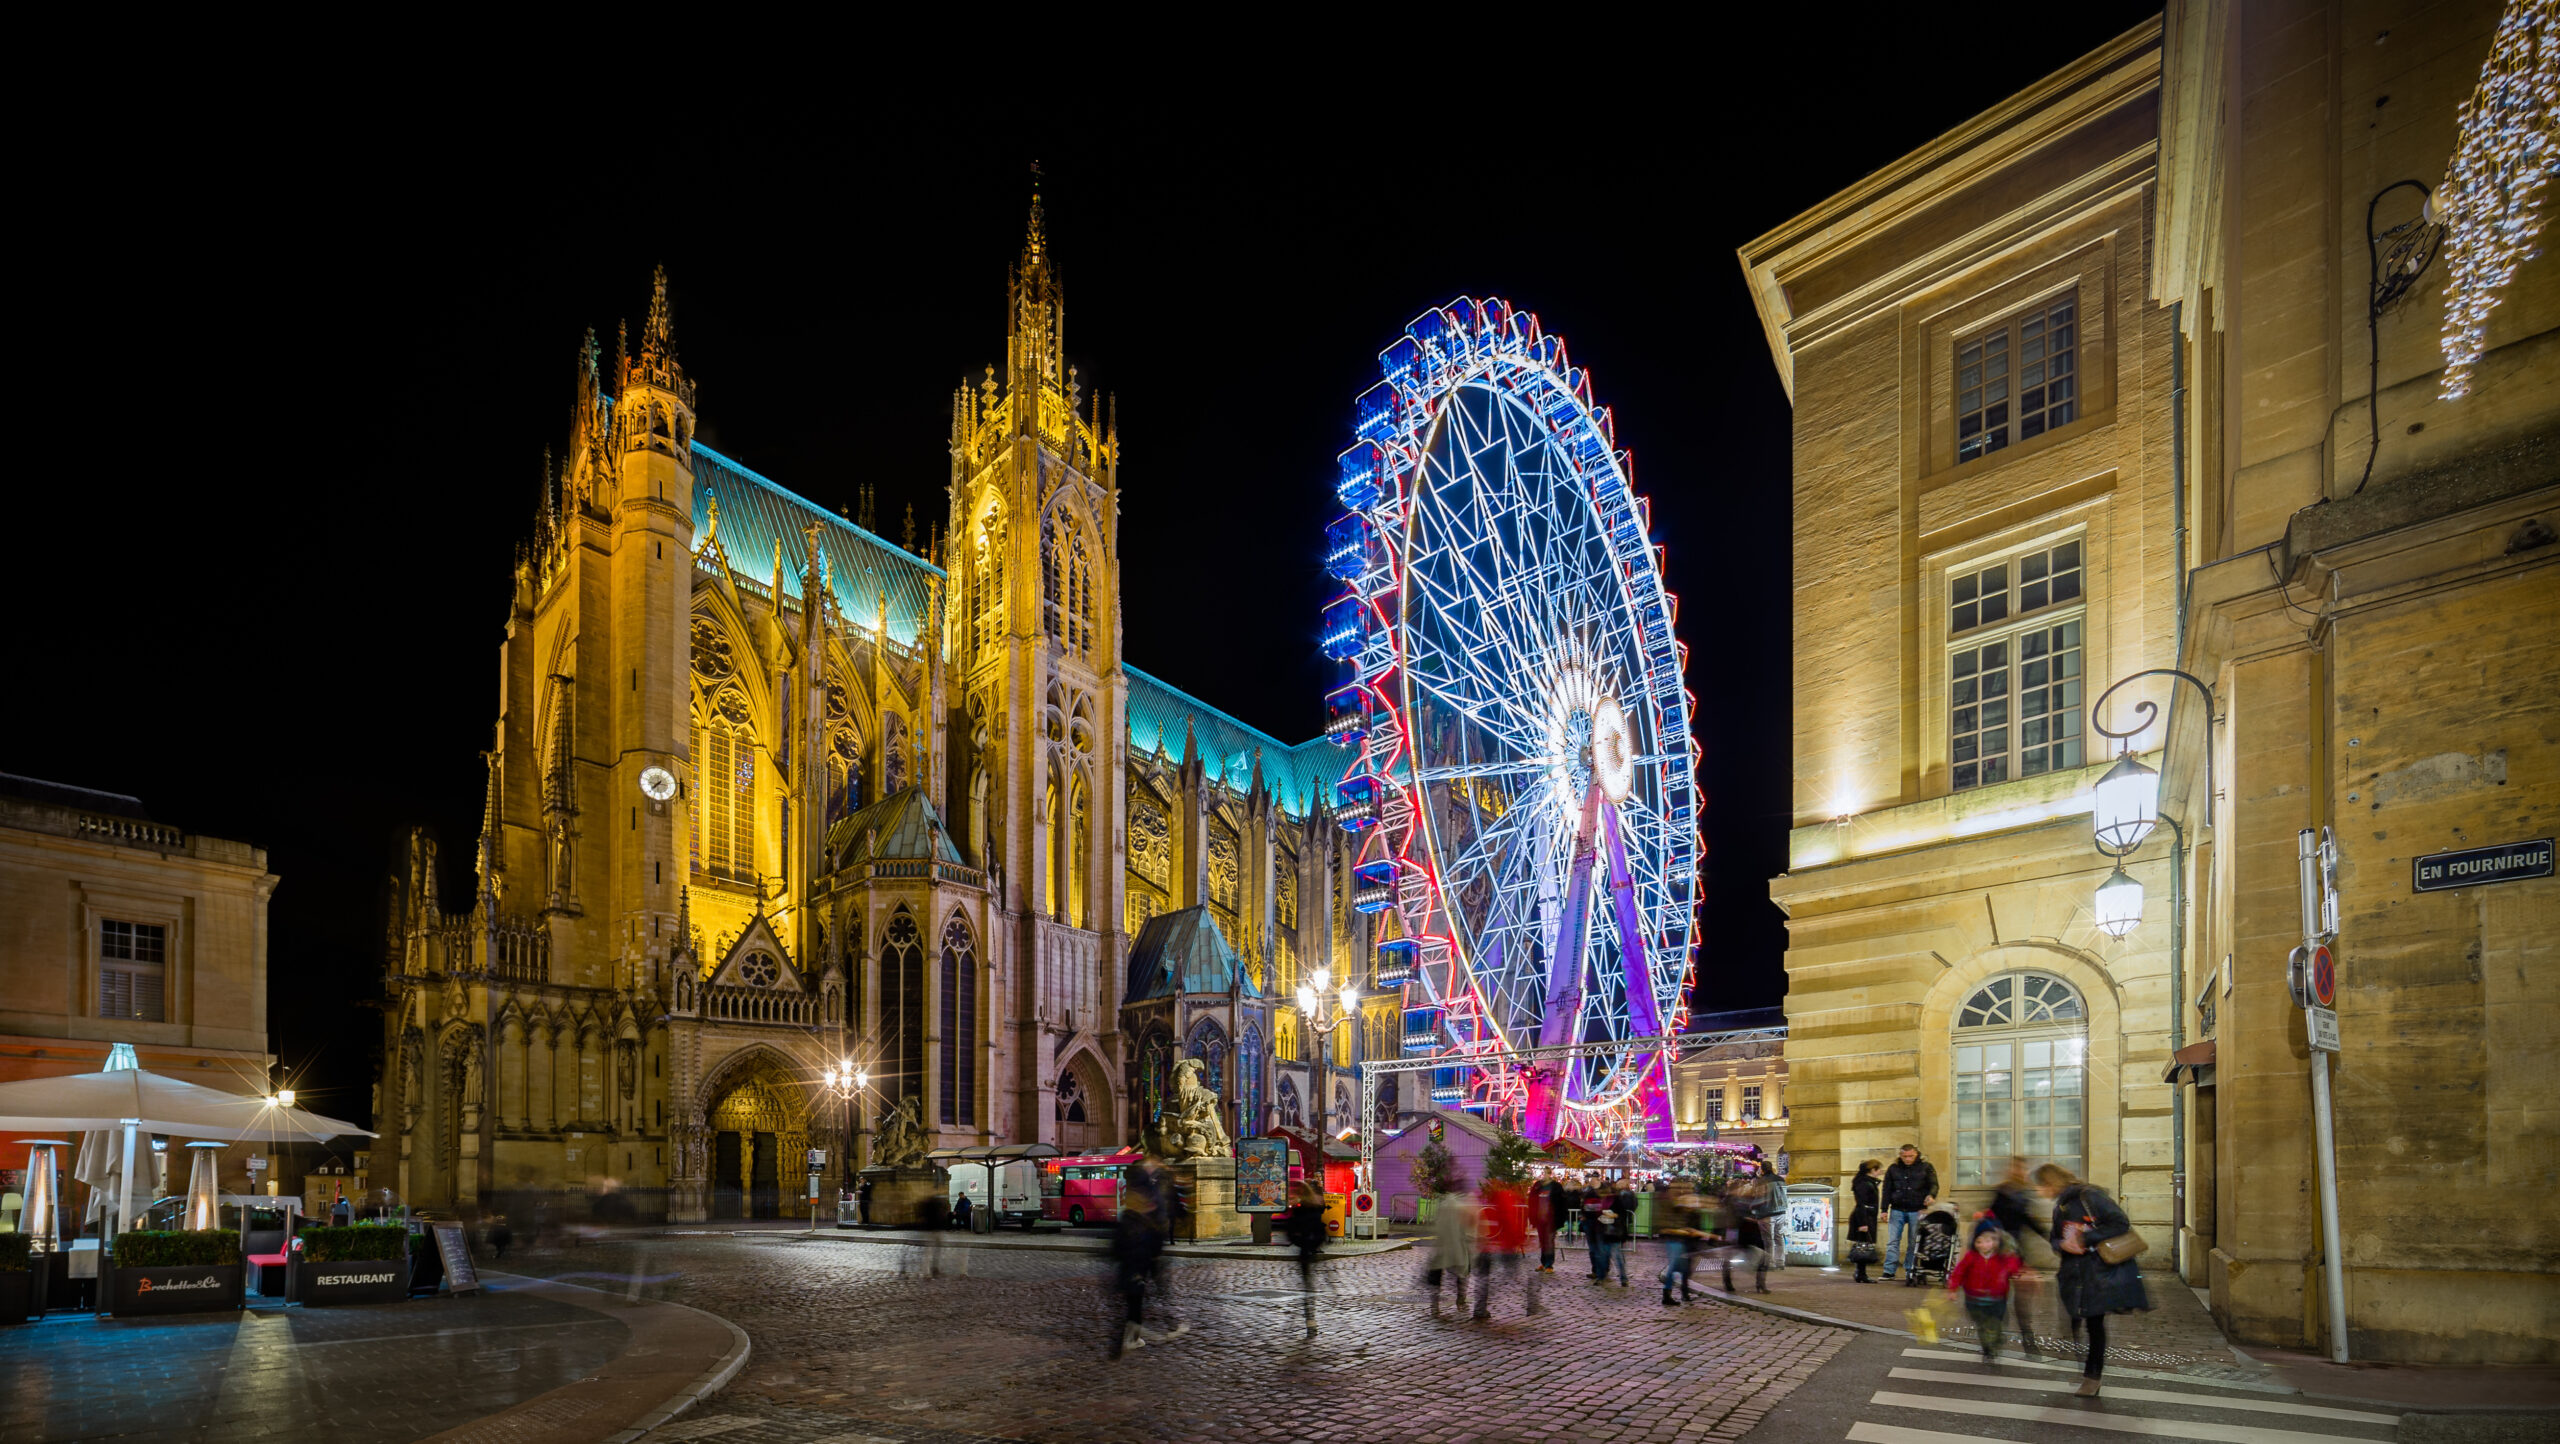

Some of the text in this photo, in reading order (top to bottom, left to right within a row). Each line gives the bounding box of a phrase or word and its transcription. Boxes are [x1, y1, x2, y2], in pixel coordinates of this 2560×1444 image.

[2420, 850, 2549, 880] EN FOURNIRUE
[316, 1273, 395, 1286] RESTAURANT
